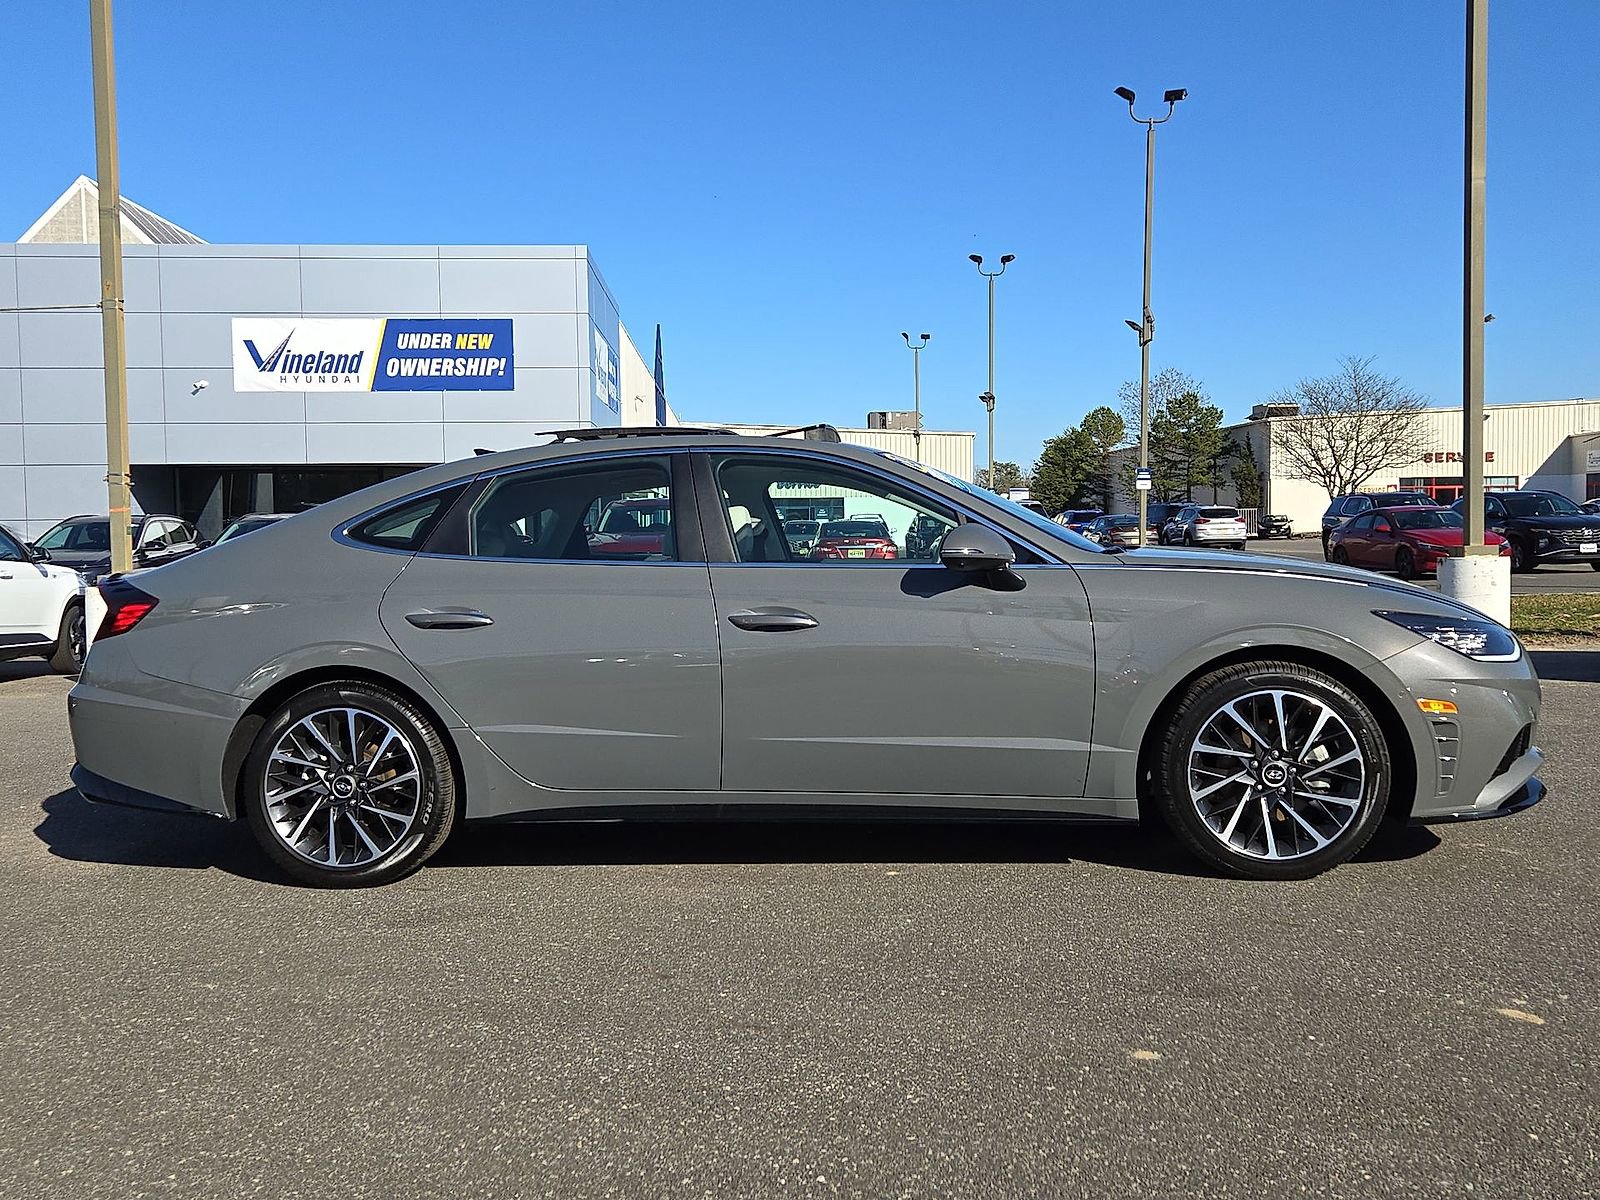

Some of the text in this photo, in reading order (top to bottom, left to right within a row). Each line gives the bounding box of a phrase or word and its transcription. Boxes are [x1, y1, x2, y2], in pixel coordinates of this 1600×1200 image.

[242, 327, 365, 374] Vineland
[396, 332, 494, 350] UNDER NEW
[386, 357, 507, 377] OWNERSHIP!
[279, 375, 361, 384] HYUNDAI
